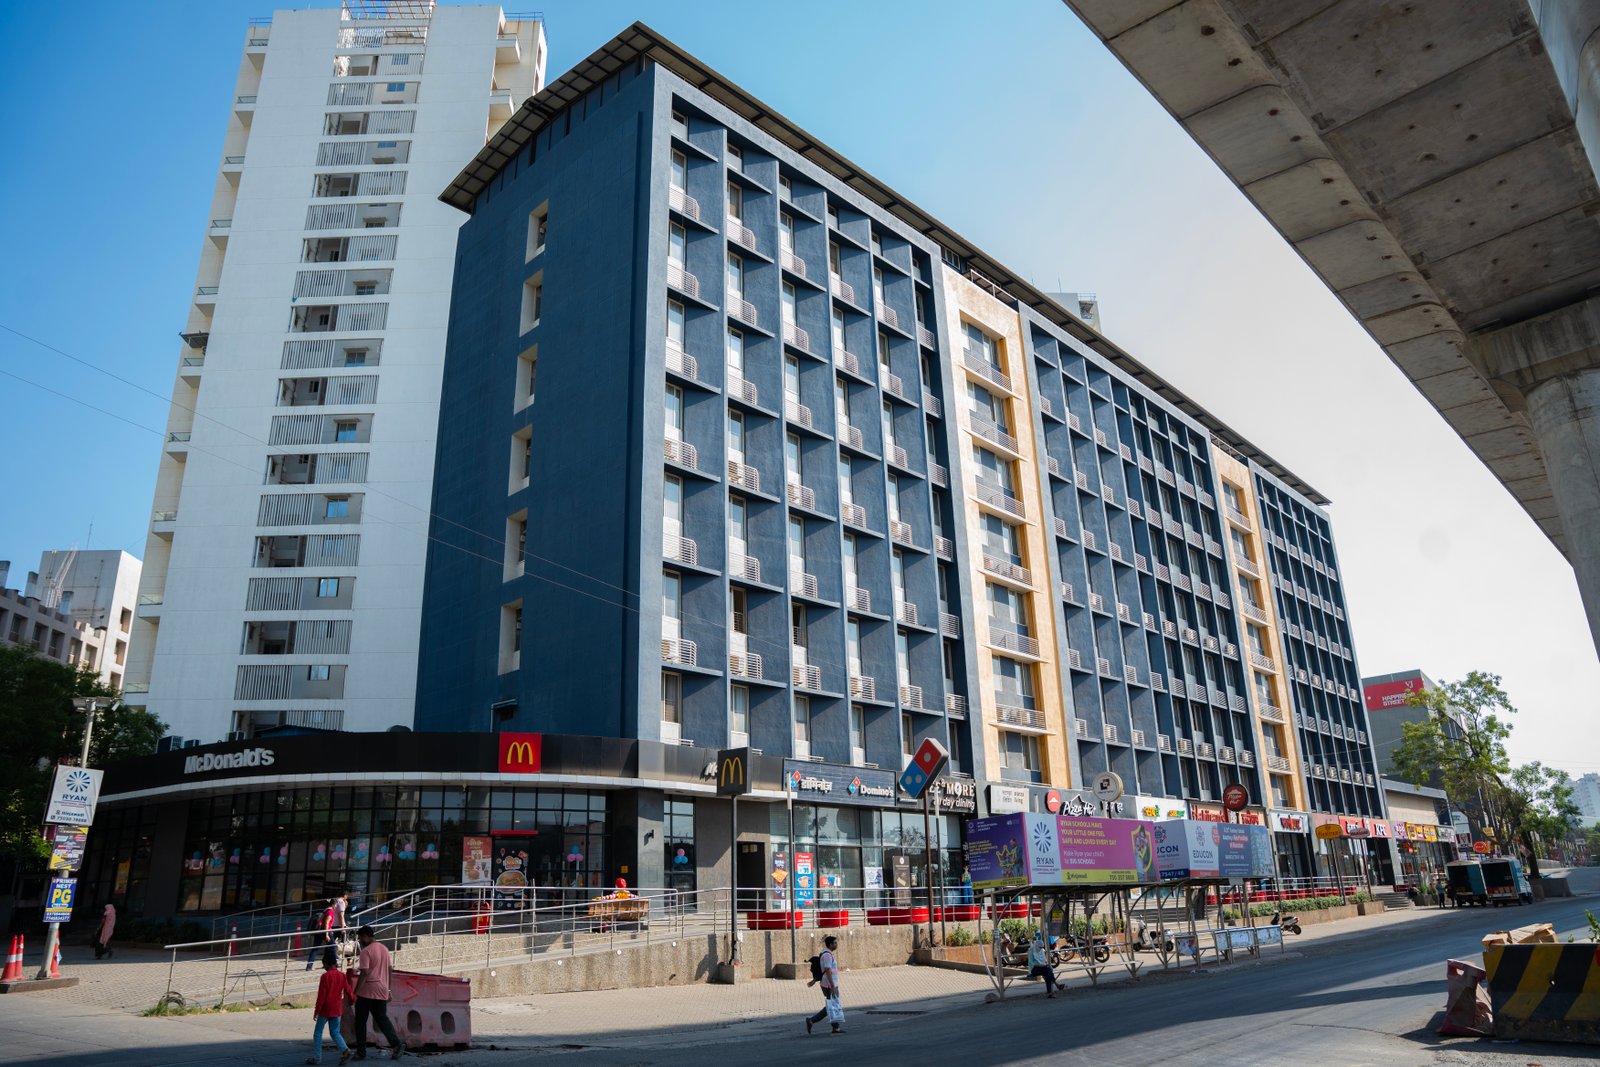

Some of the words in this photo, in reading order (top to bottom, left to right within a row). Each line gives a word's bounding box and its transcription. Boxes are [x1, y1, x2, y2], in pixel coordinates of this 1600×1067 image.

[184, 748, 275, 774] McDonald's
[860, 784, 894, 797] Domino's
[942, 797, 955, 809] day
[955, 798, 975, 811] dining
[1193, 849, 1213, 859] EDUCON
[1036, 857, 1054, 865] RYAN
[51, 889, 72, 904] PG
